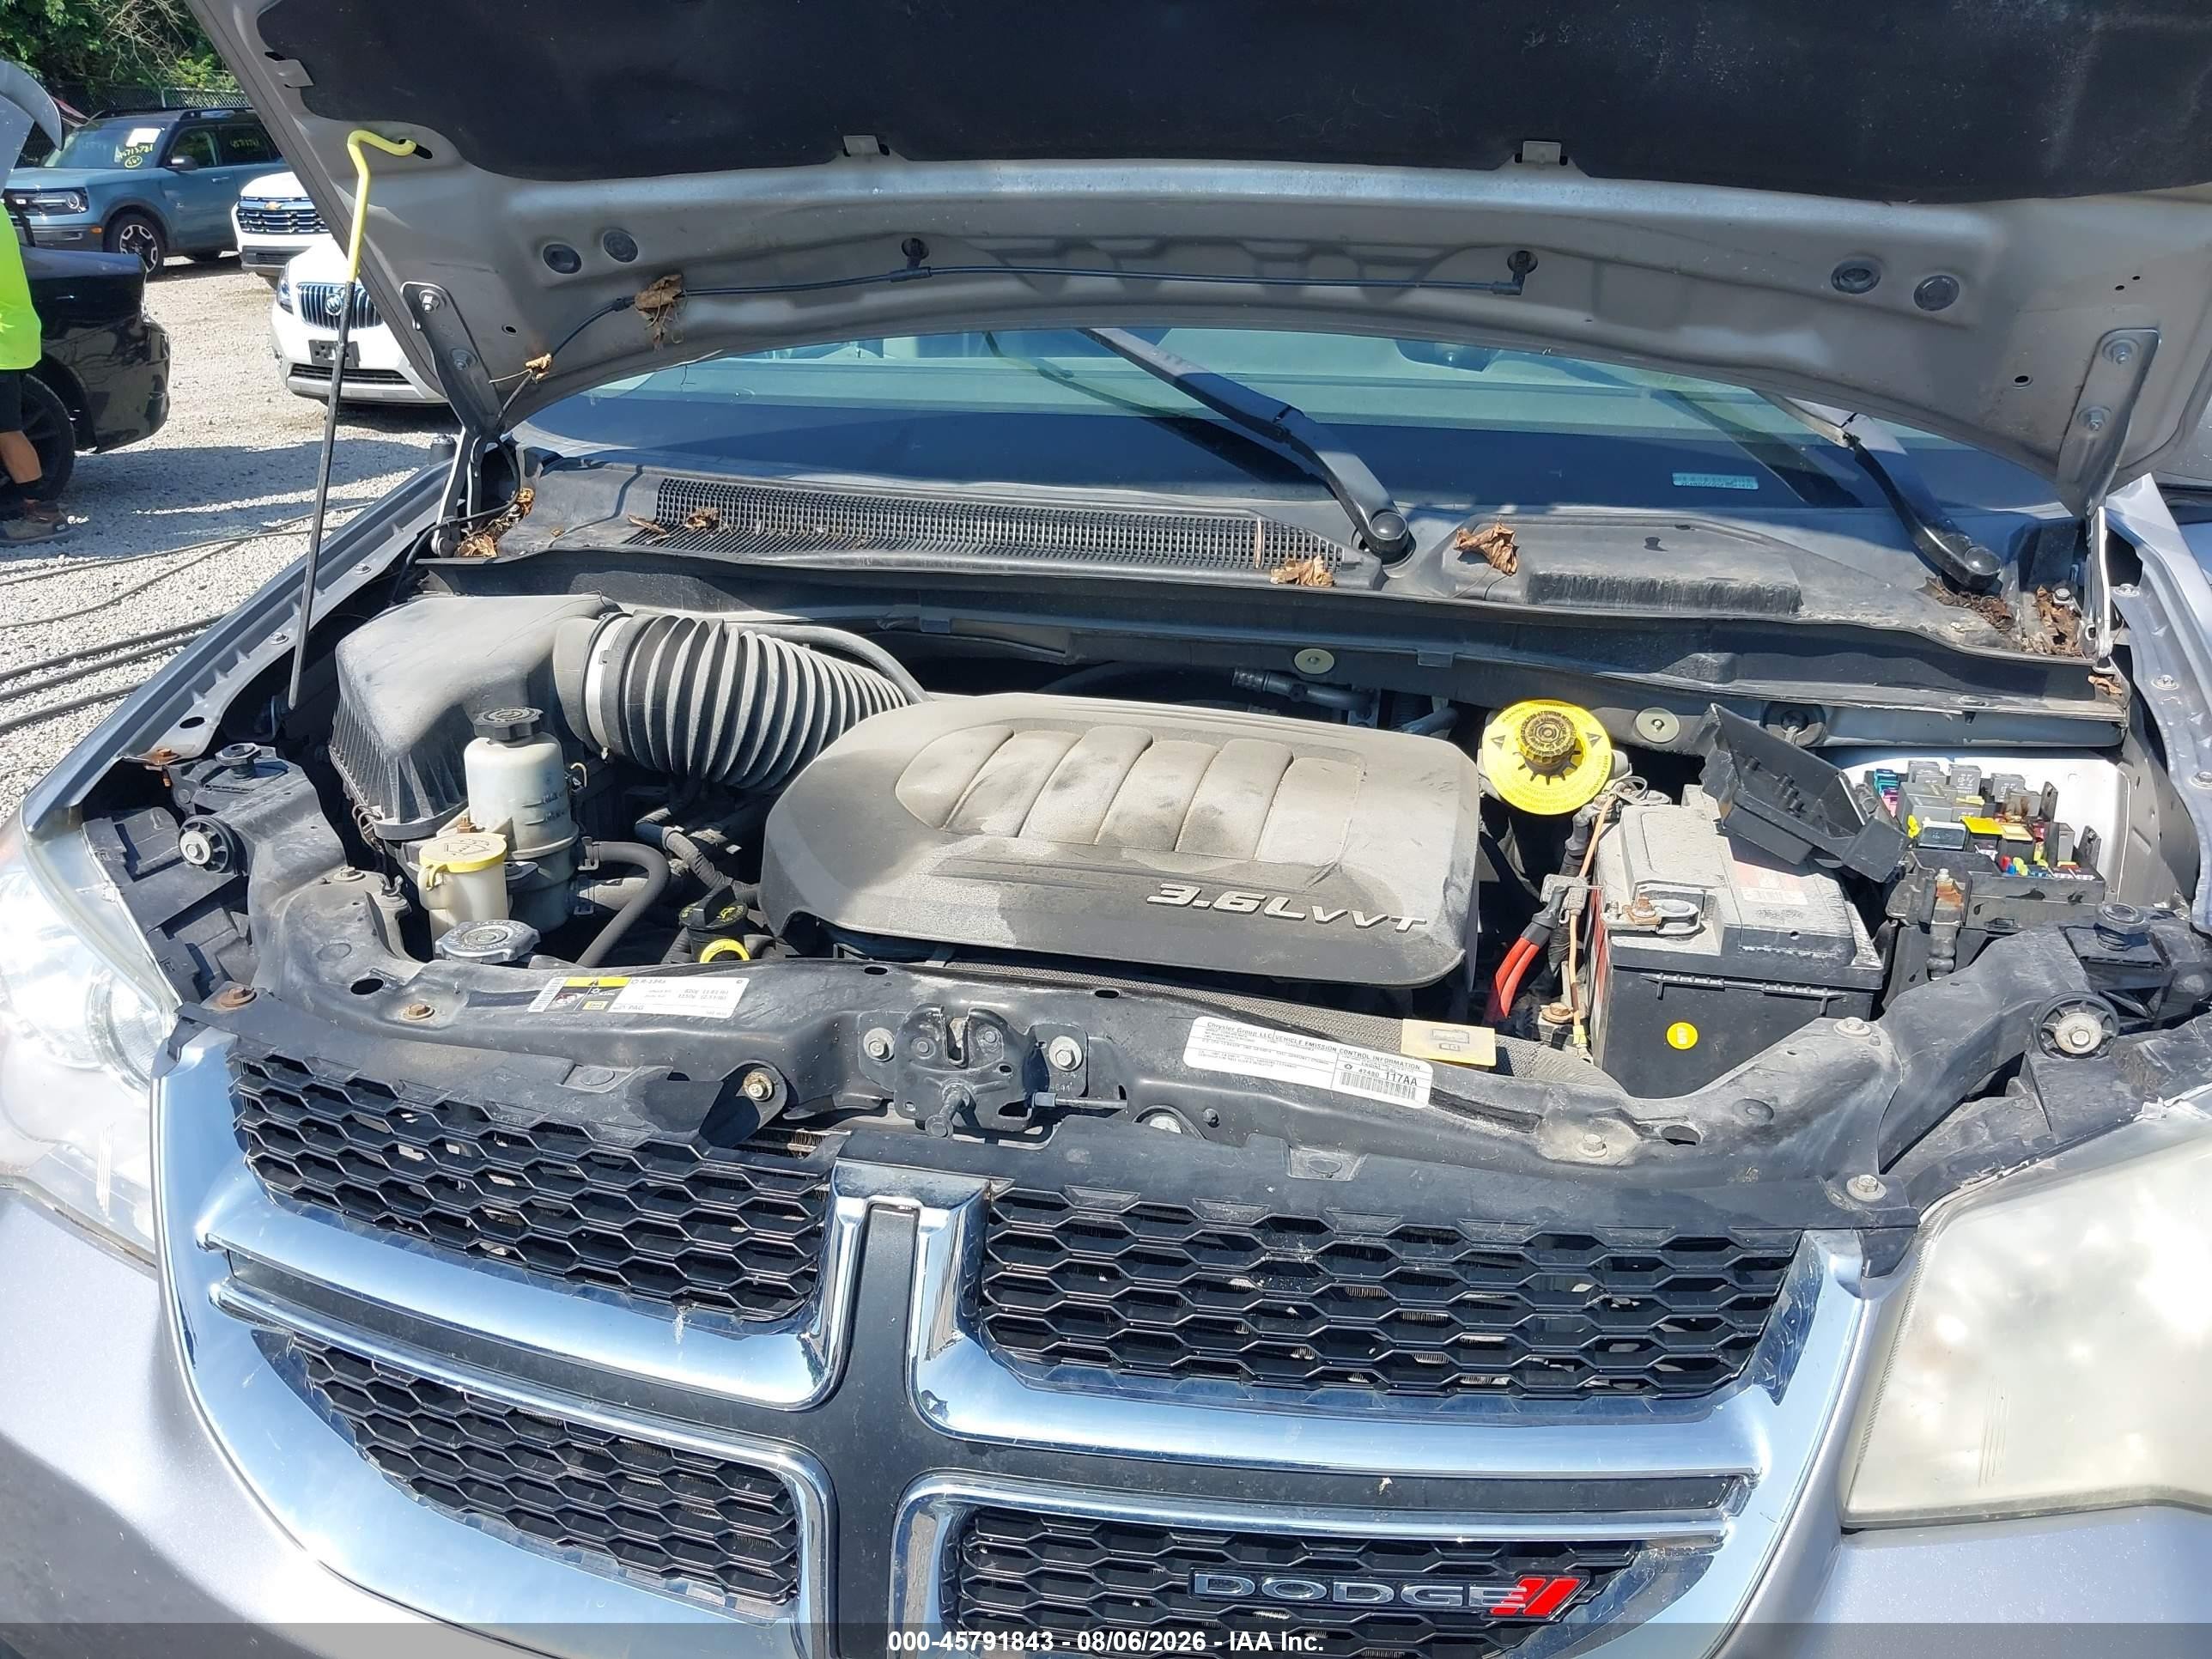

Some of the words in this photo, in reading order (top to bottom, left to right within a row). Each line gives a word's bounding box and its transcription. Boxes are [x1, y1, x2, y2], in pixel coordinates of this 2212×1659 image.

[1206, 1022, 1235, 1032] Chrysler
[1237, 1027, 1258, 1037] Group
[1275, 1034, 1303, 1046] VEHICLE
[1304, 1041, 1338, 1053] EMISSION
[1339, 1048, 1371, 1060] CONTROL
[1372, 1054, 1421, 1071] INFORMATION
[1385, 1072, 1418, 1086] 117AA
[1194, 1573, 1527, 1609] DODGE
